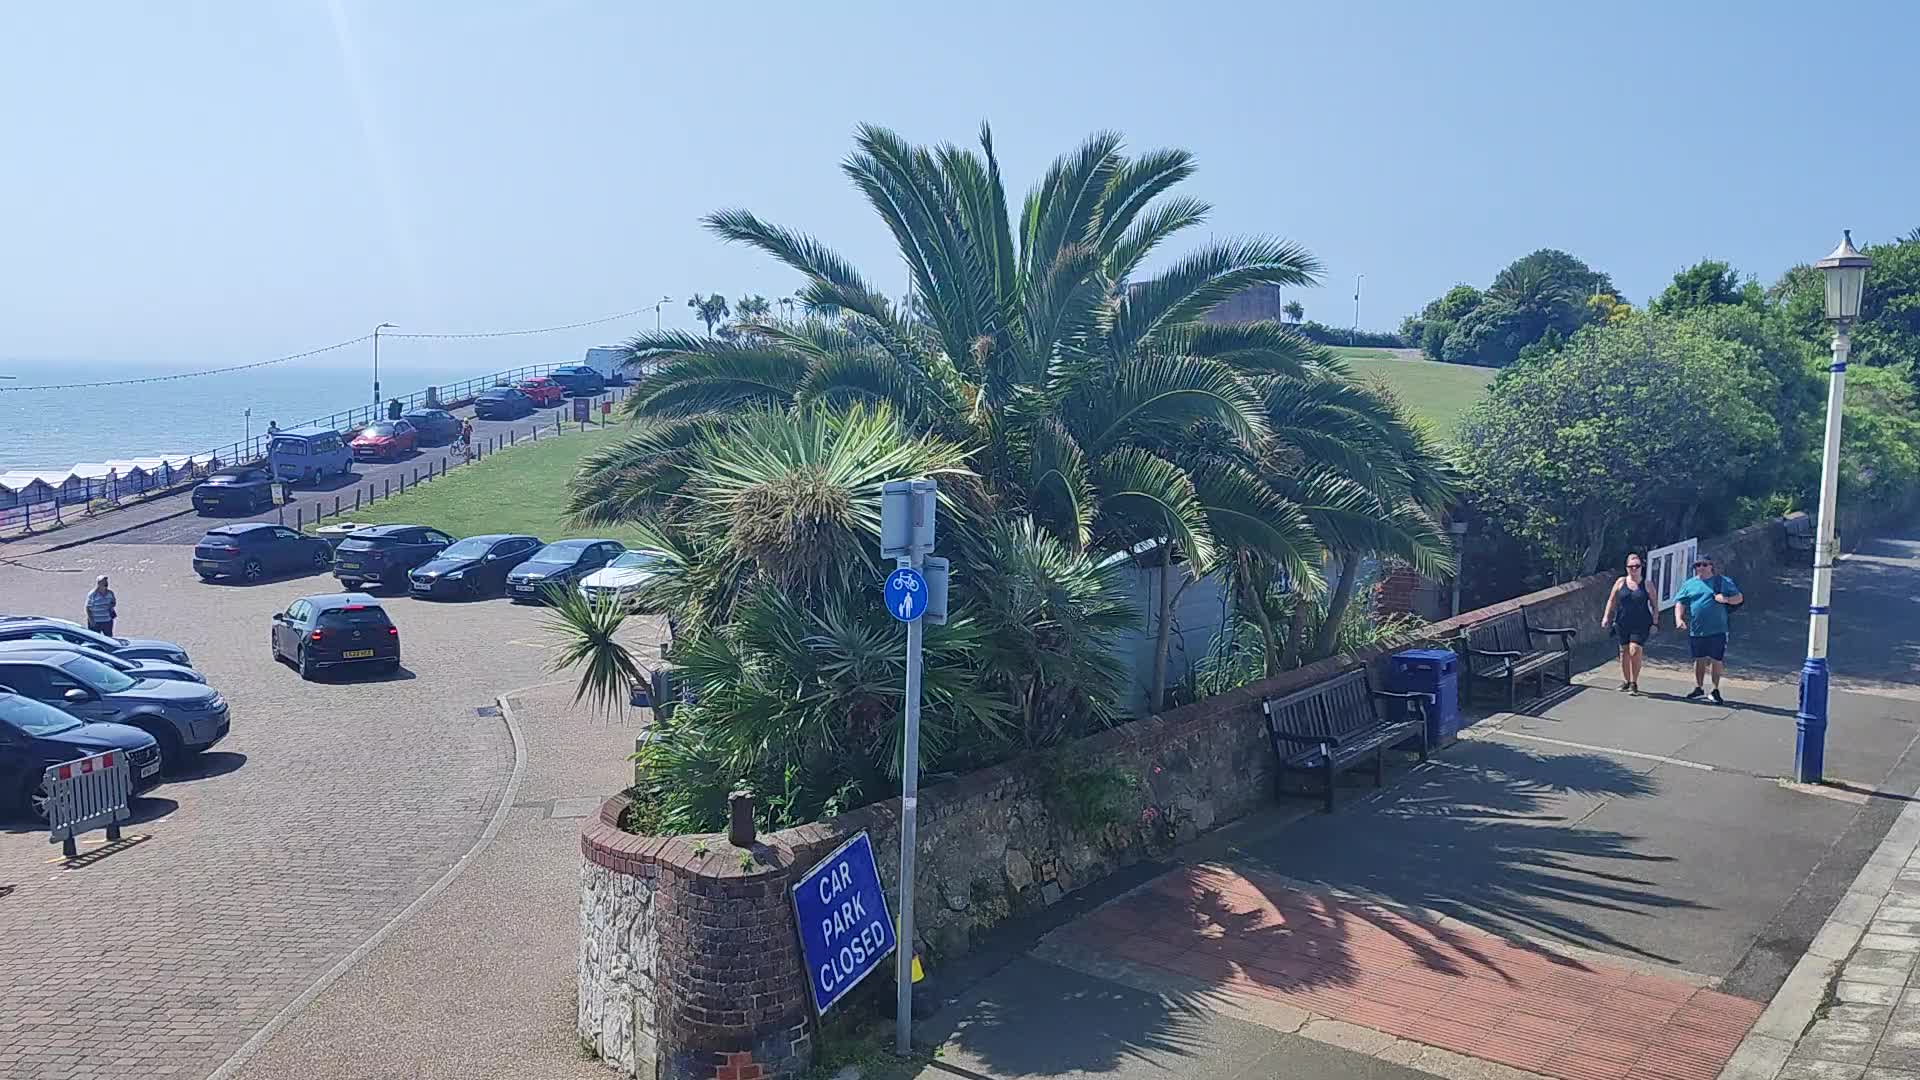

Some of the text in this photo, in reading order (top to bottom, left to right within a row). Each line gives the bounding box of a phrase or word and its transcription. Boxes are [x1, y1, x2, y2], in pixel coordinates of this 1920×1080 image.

[819, 861, 852, 905] CAR
[822, 891, 866, 947] PARK
[820, 921, 885, 992] CLOSED
